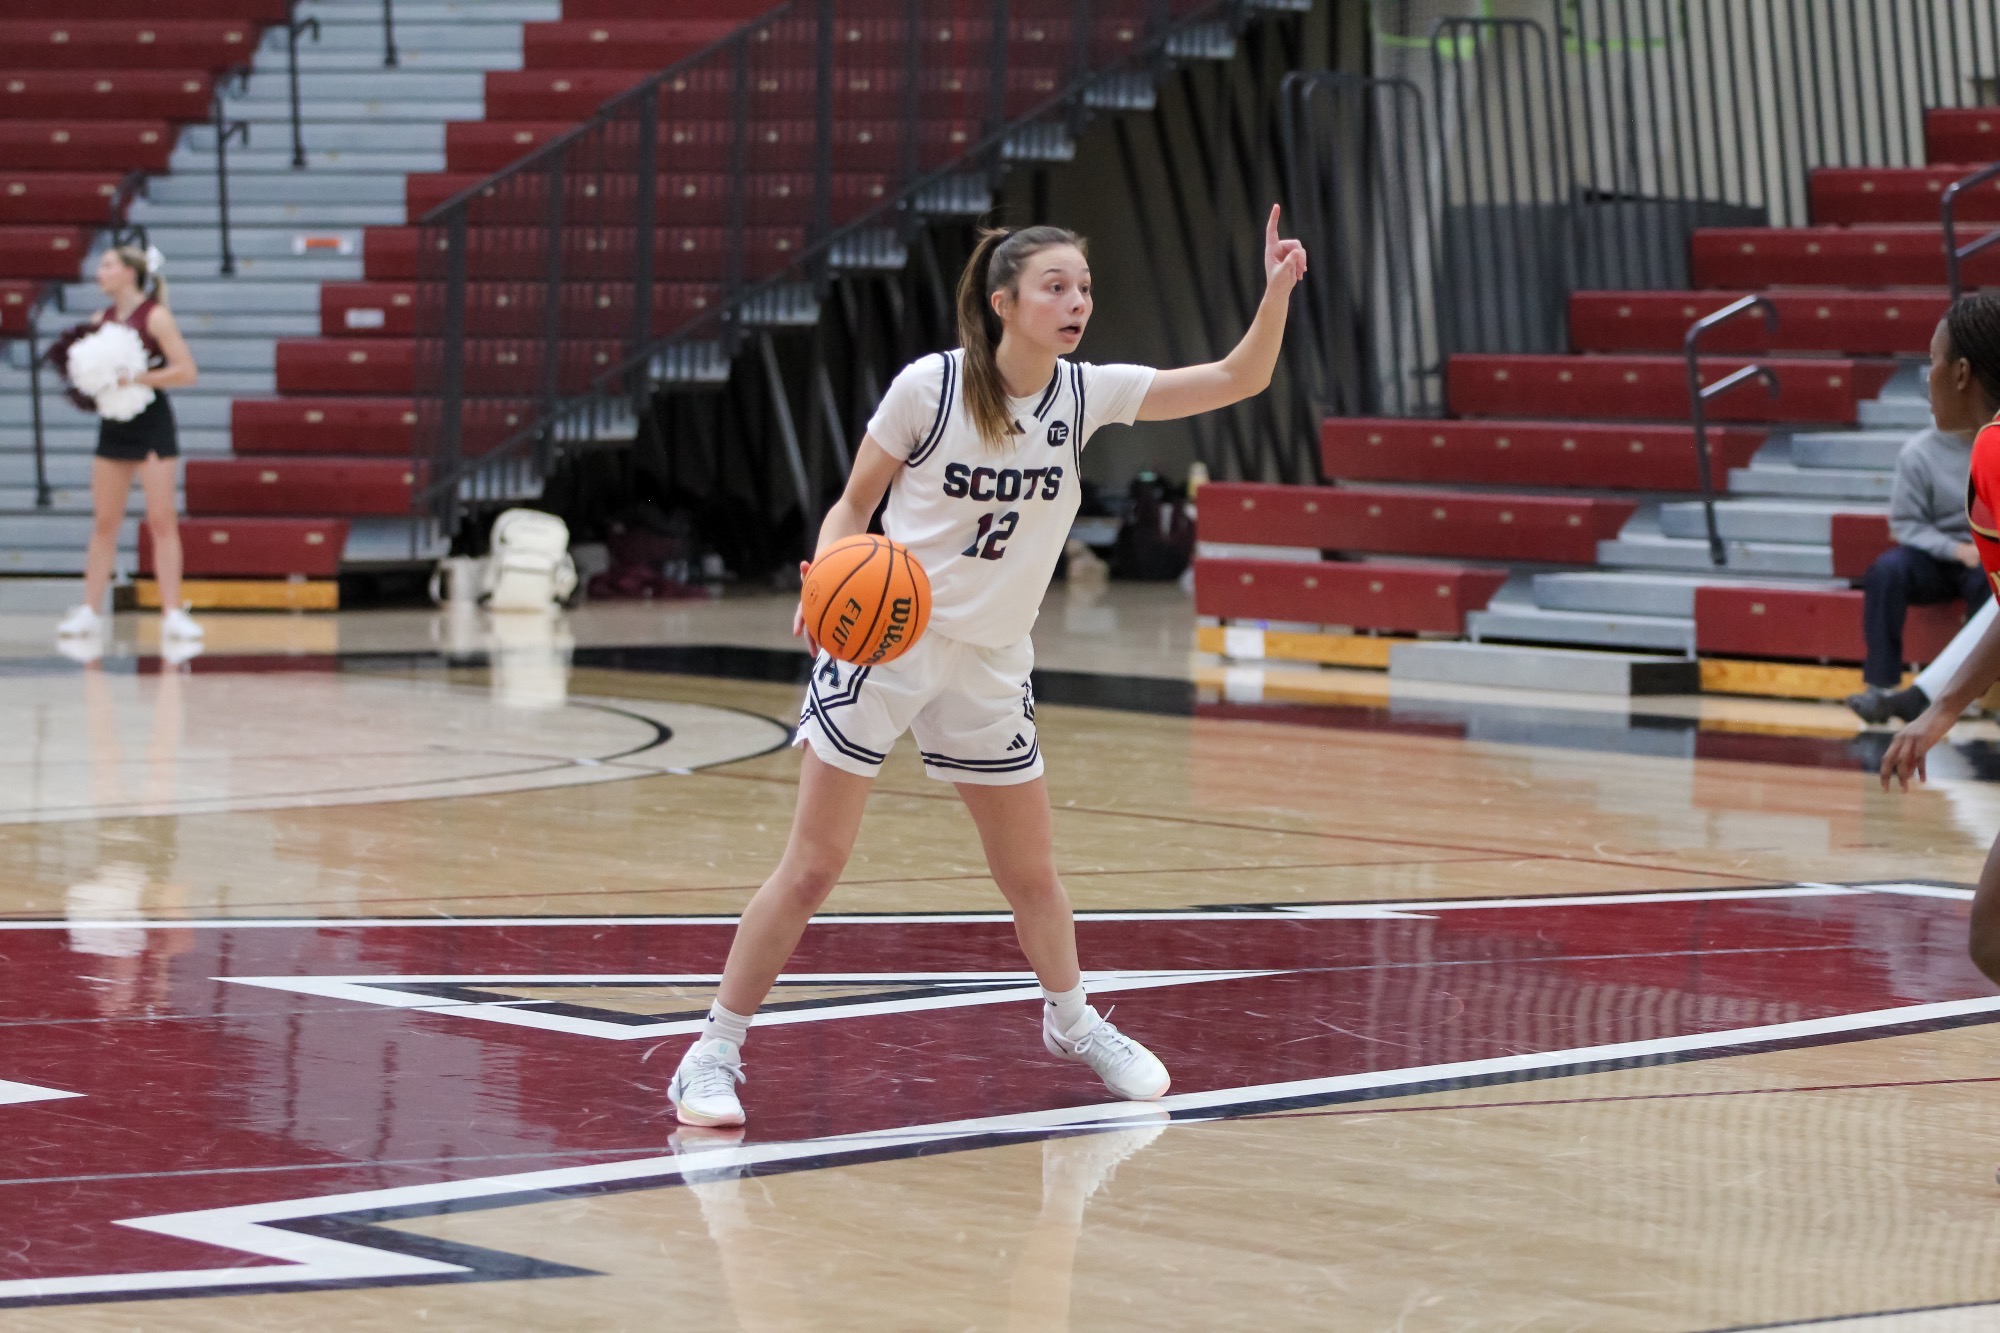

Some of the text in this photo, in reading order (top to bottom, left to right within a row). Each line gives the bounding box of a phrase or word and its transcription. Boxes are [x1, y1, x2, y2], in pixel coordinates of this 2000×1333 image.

[1049, 426, 1067, 442] TE
[943, 462, 1064, 502] SCOTS
[961, 511, 1020, 561] 12
[862, 597, 912, 664] Wilson
